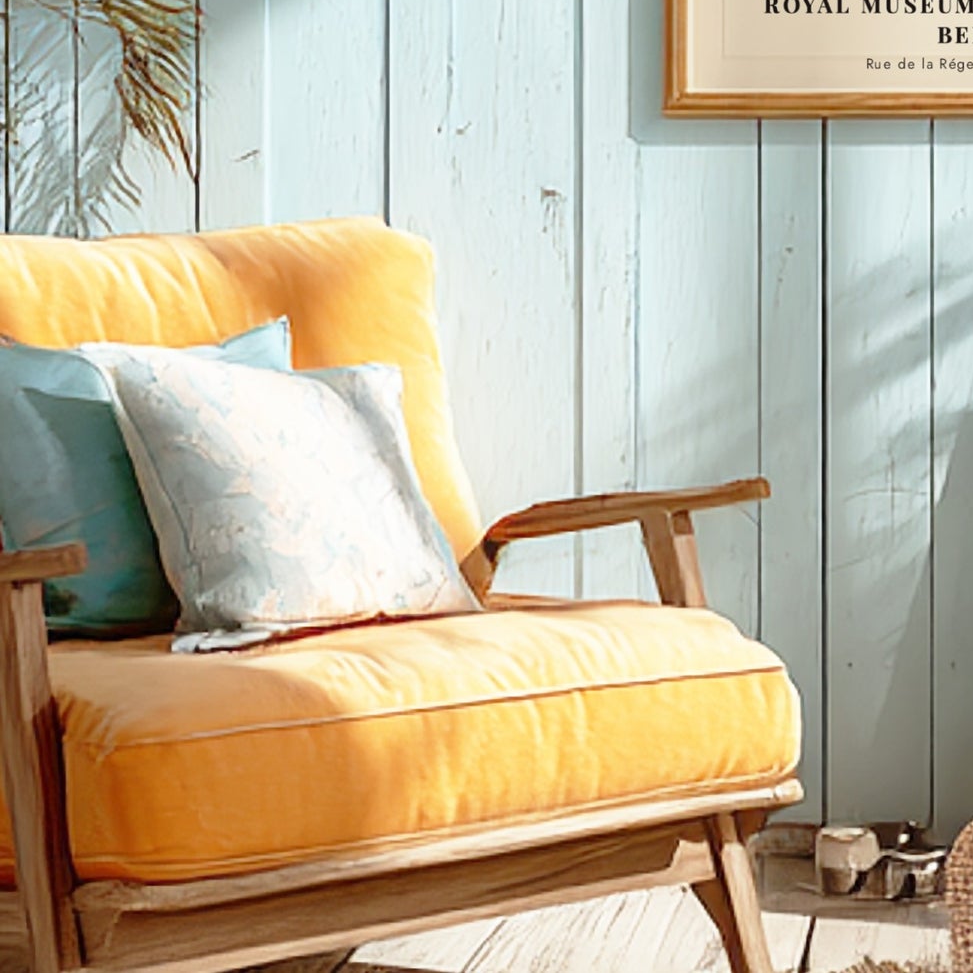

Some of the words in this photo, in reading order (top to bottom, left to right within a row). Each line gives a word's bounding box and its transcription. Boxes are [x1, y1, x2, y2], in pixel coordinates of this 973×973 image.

[866, 57, 892, 70] Rue
[897, 56, 916, 70] de
[921, 56, 934, 70] la
